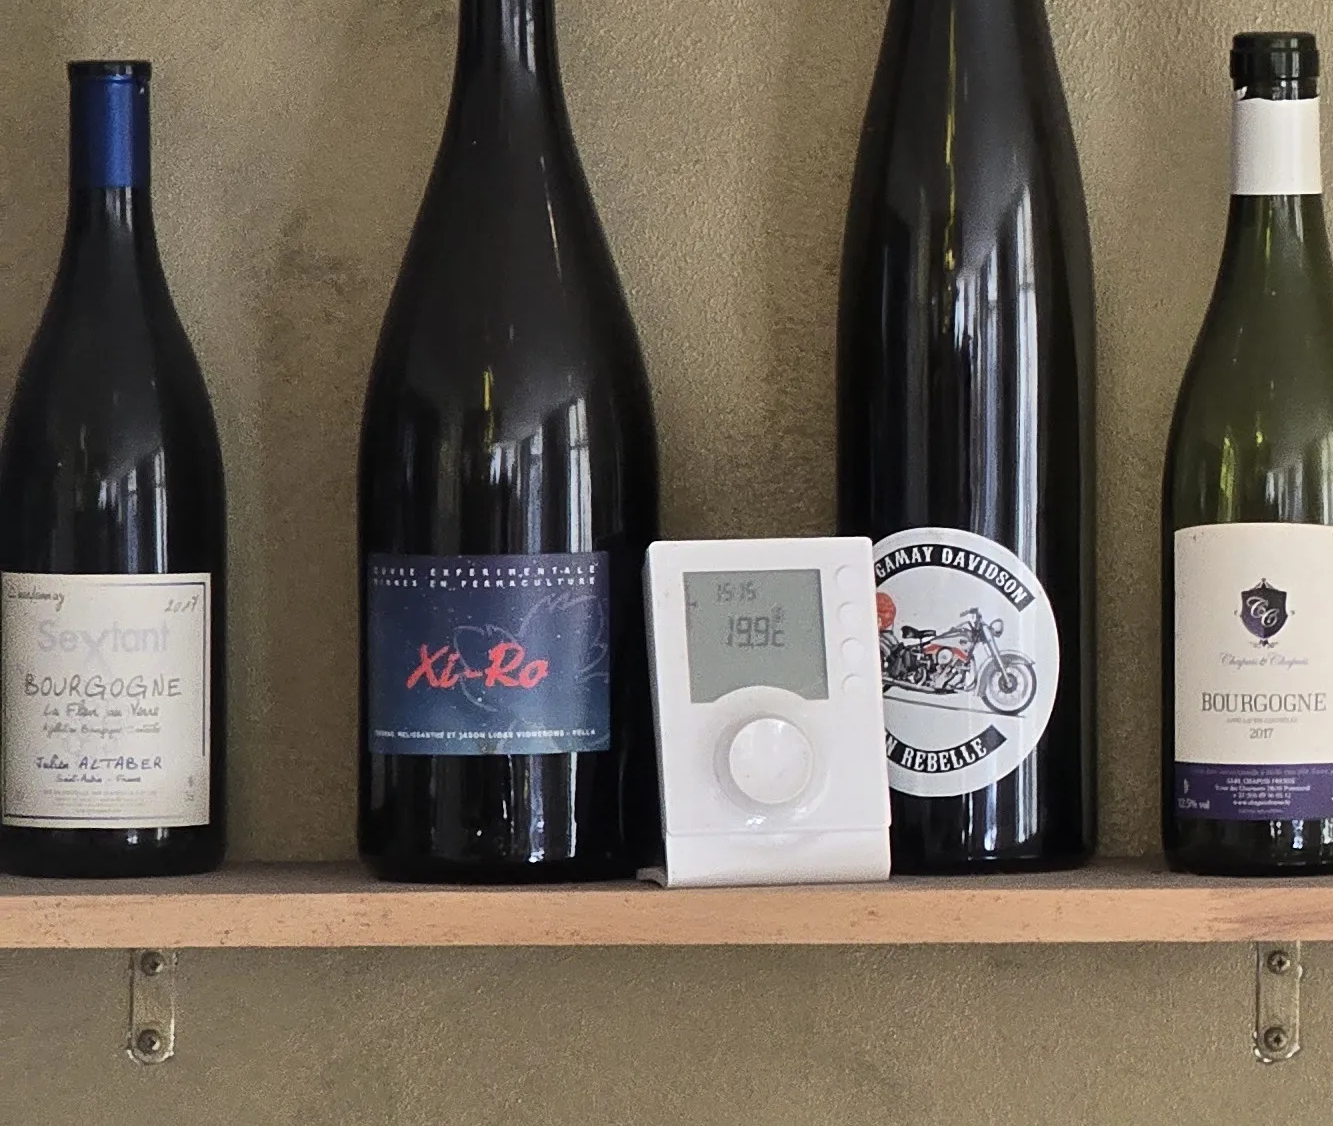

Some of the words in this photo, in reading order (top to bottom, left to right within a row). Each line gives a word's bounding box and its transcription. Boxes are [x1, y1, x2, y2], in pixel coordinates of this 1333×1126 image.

[875, 546, 934, 578] GAMAY
[941, 547, 1028, 604] DAVIDSON
[24, 673, 182, 700] BOURGOGNE
[1200, 692, 1327, 713] BOURGOGNE
[1249, 727, 1275, 739] 2017
[79, 756, 163, 770] ALTABER
[901, 737, 987, 773] REBELLE
